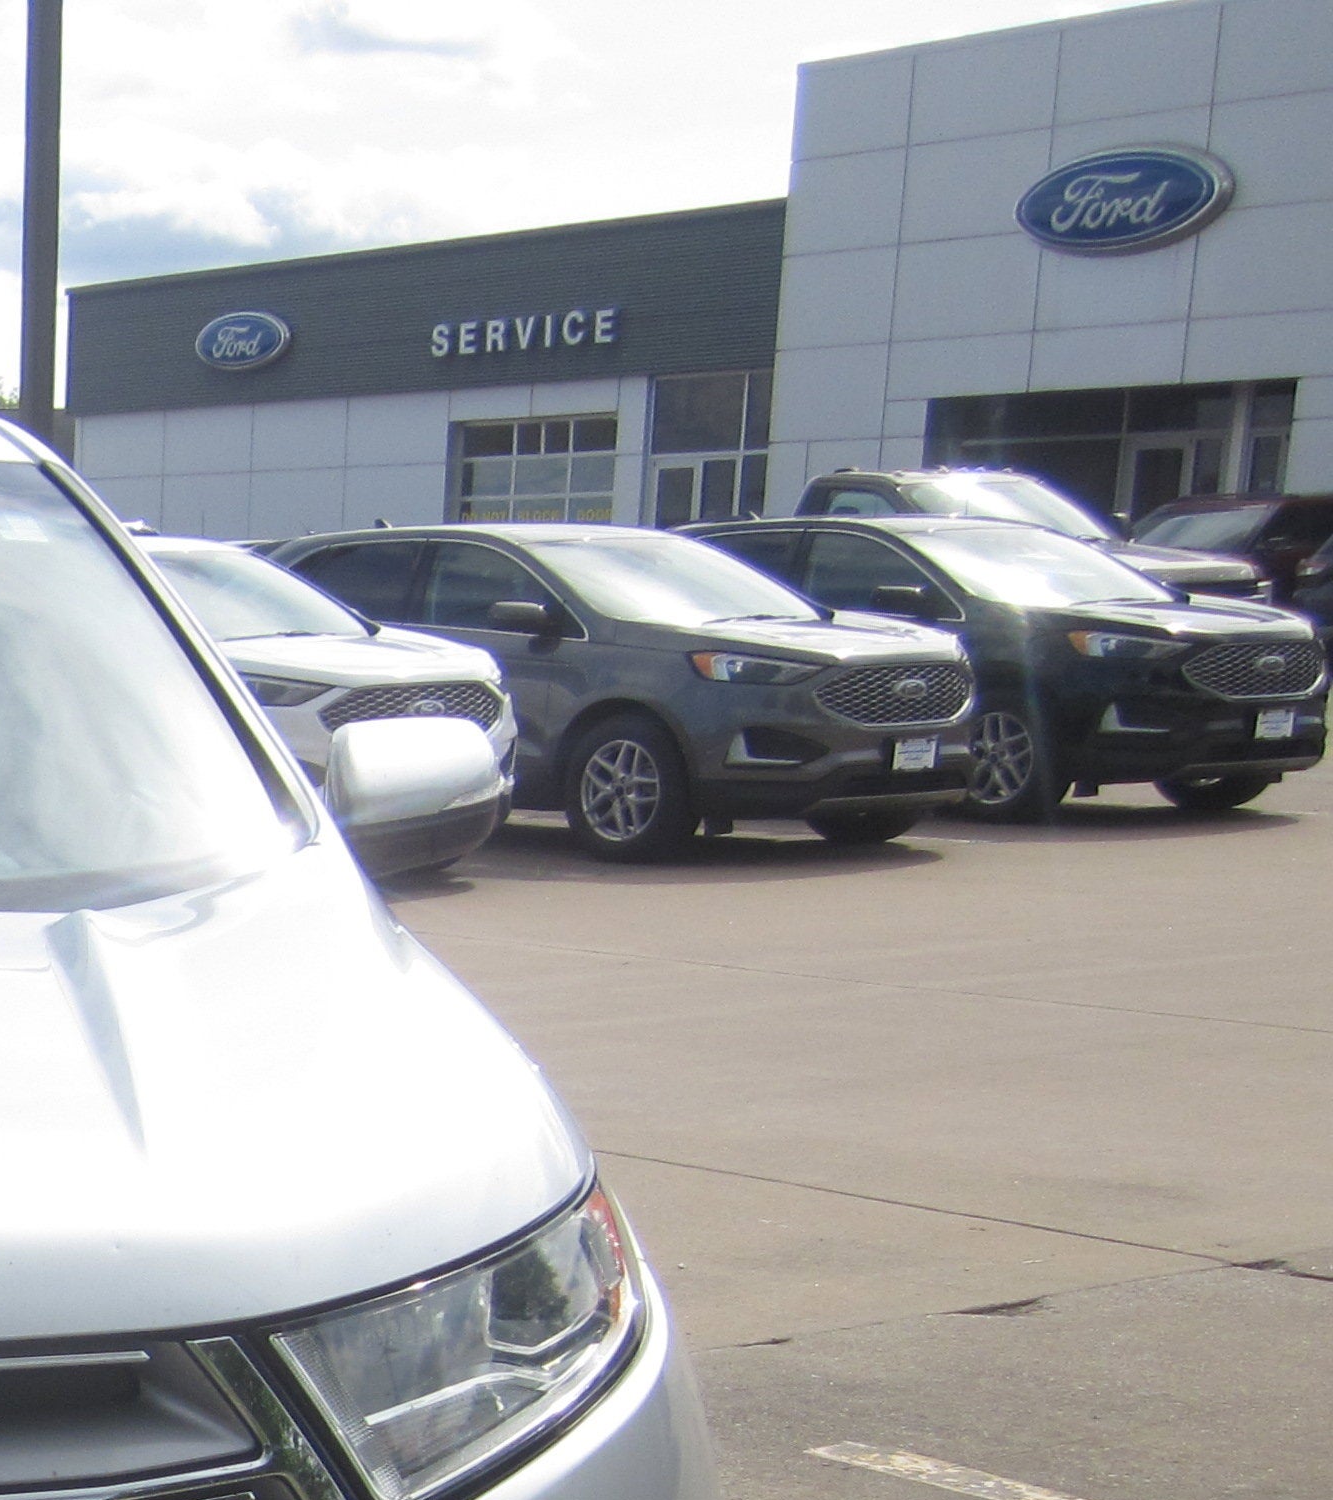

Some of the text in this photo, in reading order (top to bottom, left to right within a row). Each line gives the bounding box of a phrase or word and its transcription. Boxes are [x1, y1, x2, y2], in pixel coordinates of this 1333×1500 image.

[1050, 171, 1170, 234] Ford
[213, 325, 262, 358] Ford
[431, 308, 614, 357] SERVICE
